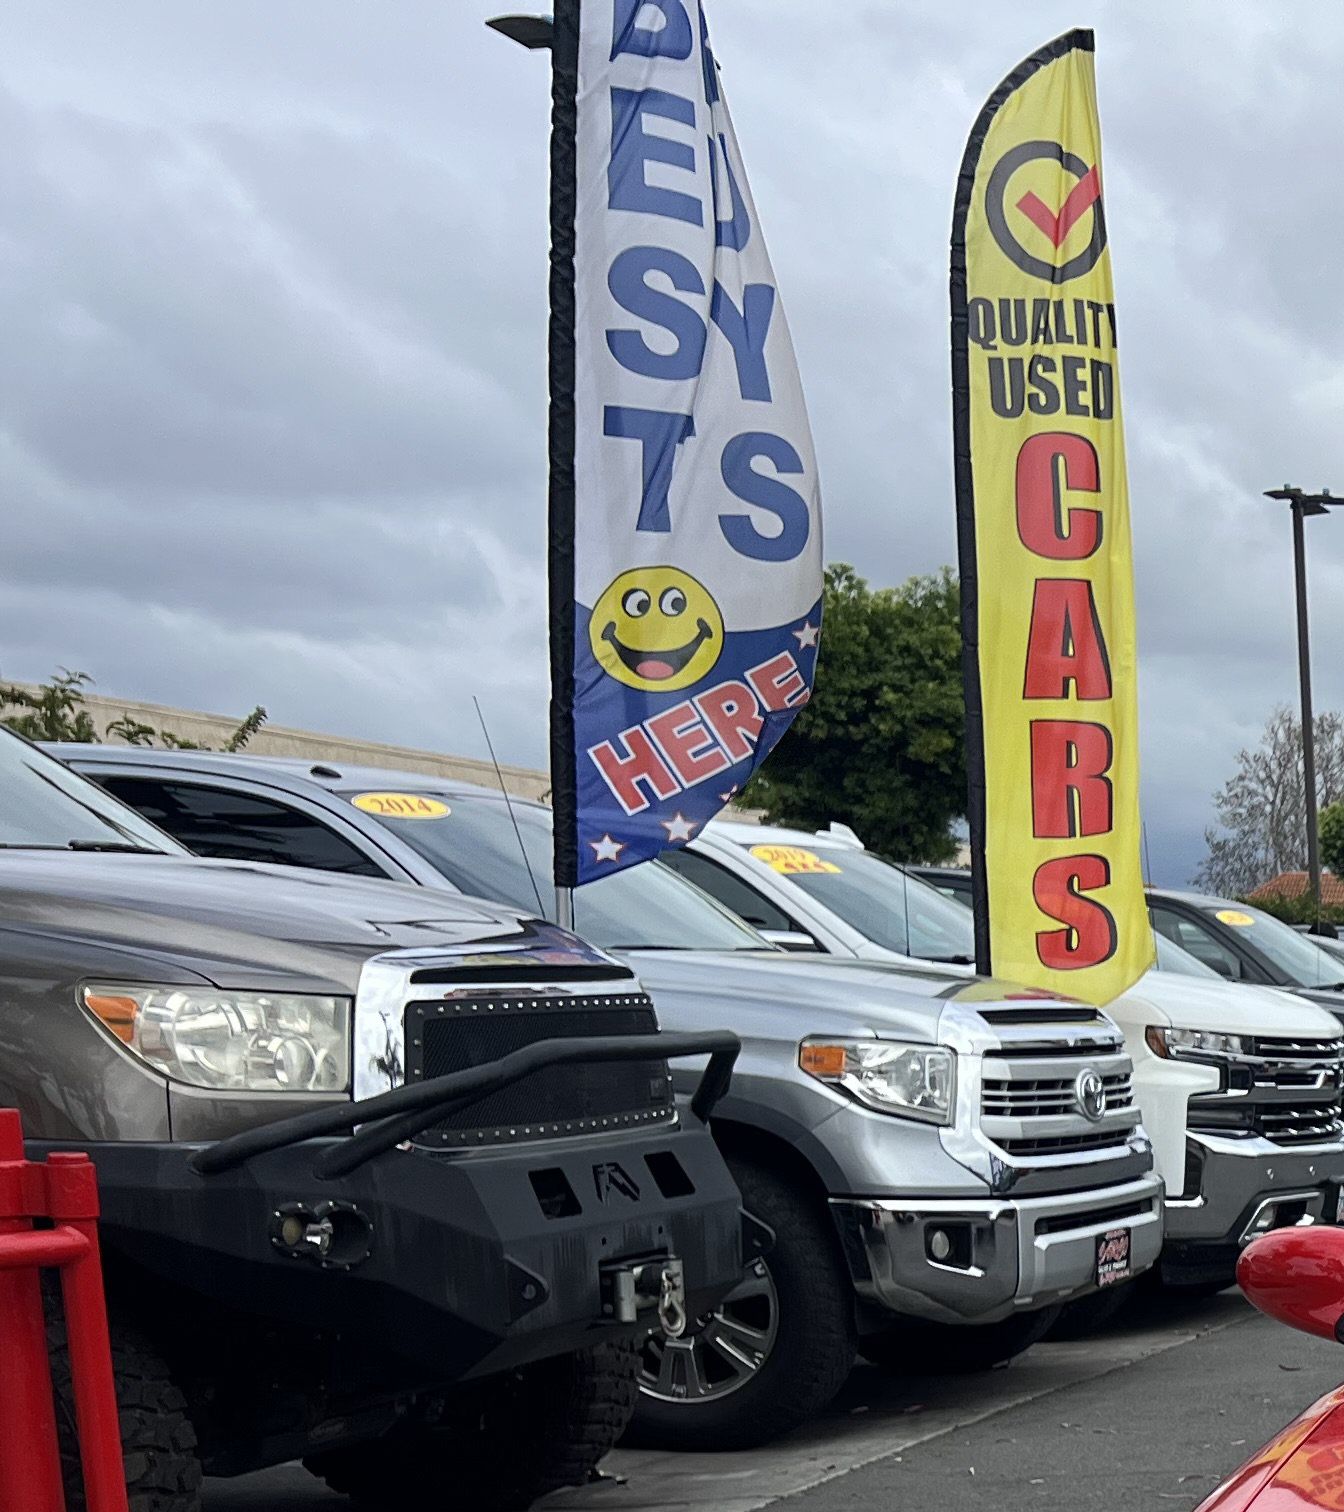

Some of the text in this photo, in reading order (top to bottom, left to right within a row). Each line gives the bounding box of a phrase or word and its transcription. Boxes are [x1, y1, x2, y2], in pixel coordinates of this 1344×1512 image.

[968, 297, 1117, 350] QUALITY
[988, 354, 1113, 420] USED
[588, 650, 811, 816] HERE
[1016, 432, 1117, 970] CARS
